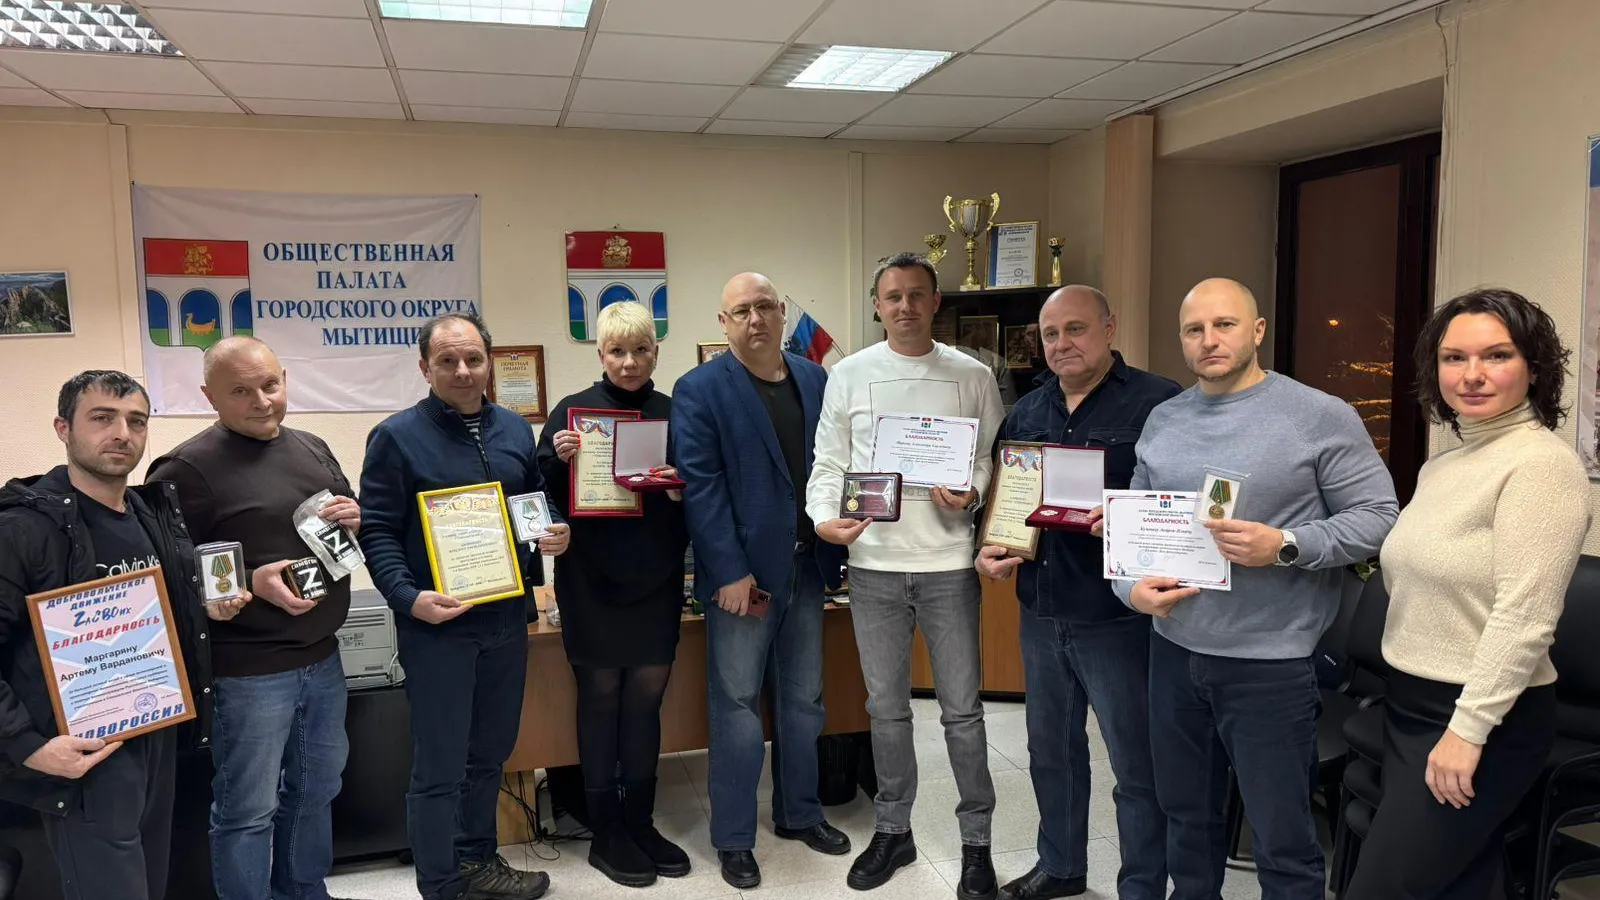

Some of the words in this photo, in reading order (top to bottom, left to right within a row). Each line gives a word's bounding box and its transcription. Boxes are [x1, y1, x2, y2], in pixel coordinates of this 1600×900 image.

[263, 242, 455, 264] ОБЩЕСТВЕННАЯ
[317, 271, 407, 290] ПАЛАТА
[256, 300, 396, 321] ГОРОДСКОГО
[401, 299, 479, 318] ОКРУГА
[323, 529, 350, 555] Z
[297, 566, 323, 591] Z
[46, 578, 147, 610] ДОБРОВОЛЬЧЕСКОЕ
[70, 590, 128, 611] ДВИЖЕНИЕ
[52, 616, 160, 650] БЛАГОДАРНОСТЬ
[60, 667, 98, 682] Артему
[100, 648, 166, 671] Вардановичу
[84, 645, 138, 665] Маргаряну
